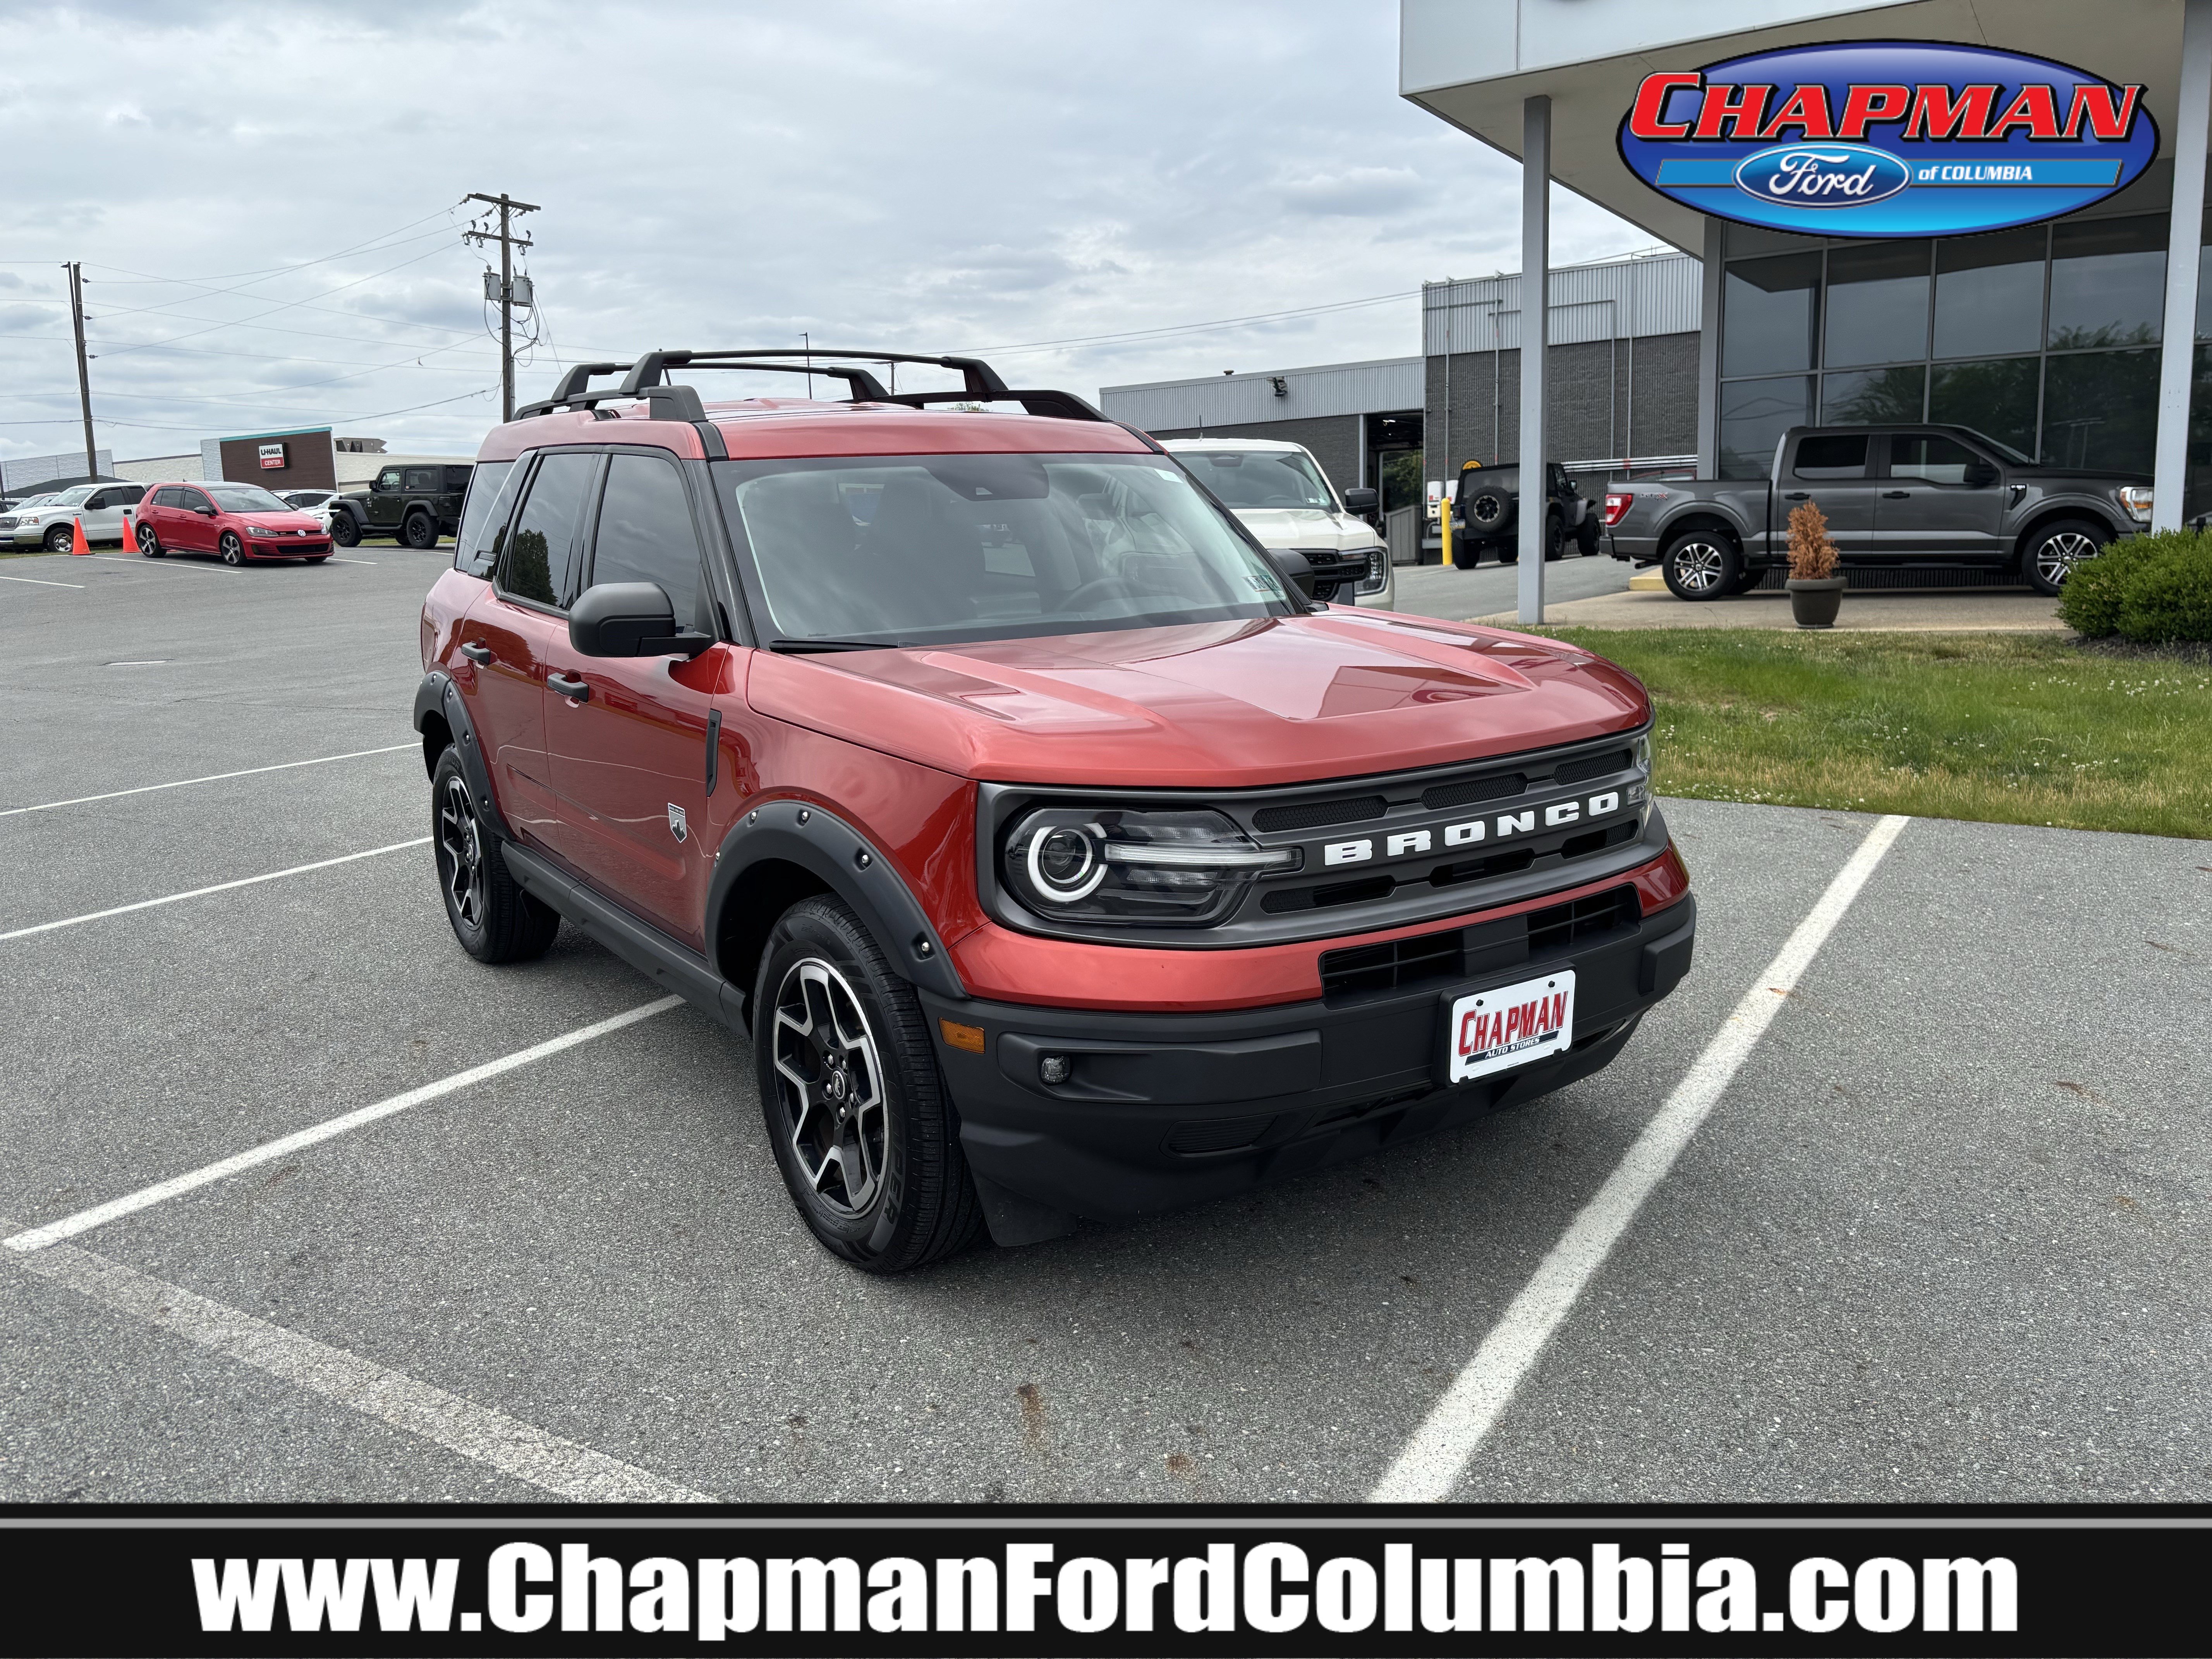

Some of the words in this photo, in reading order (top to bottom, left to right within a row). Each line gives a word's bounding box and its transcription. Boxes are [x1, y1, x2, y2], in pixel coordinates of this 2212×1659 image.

[1324, 792, 1619, 866] BRONCO
[1458, 991, 1568, 1056] CHAPMAN
[1485, 1046, 1508, 1059] AUTO
[1510, 1036, 1540, 1051] STORES
